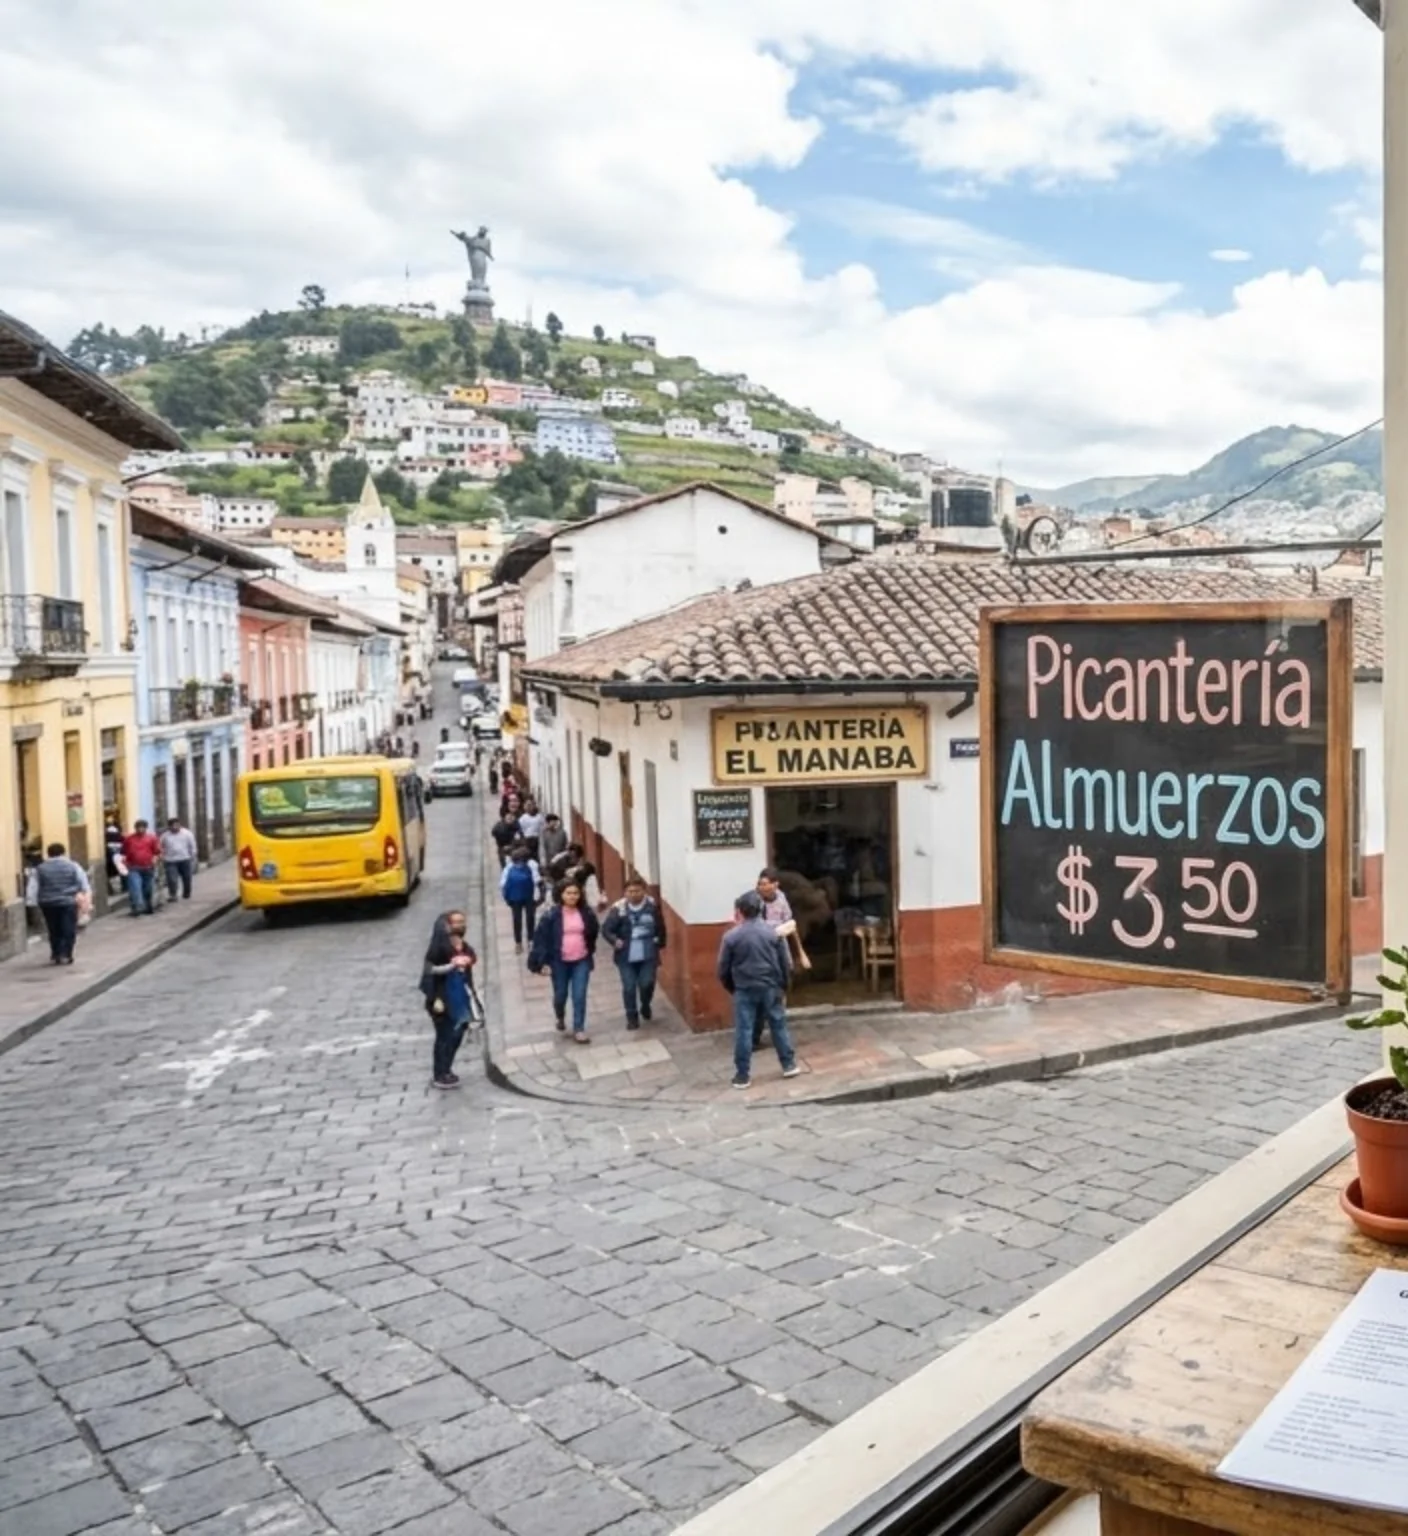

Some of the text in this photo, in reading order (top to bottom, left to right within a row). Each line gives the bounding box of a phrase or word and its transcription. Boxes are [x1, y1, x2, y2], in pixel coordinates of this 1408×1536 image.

[1027, 634, 1312, 728] Picantería
[726, 745, 916, 774] EL MANABA
[1001, 738, 1325, 850] Almuerzos
